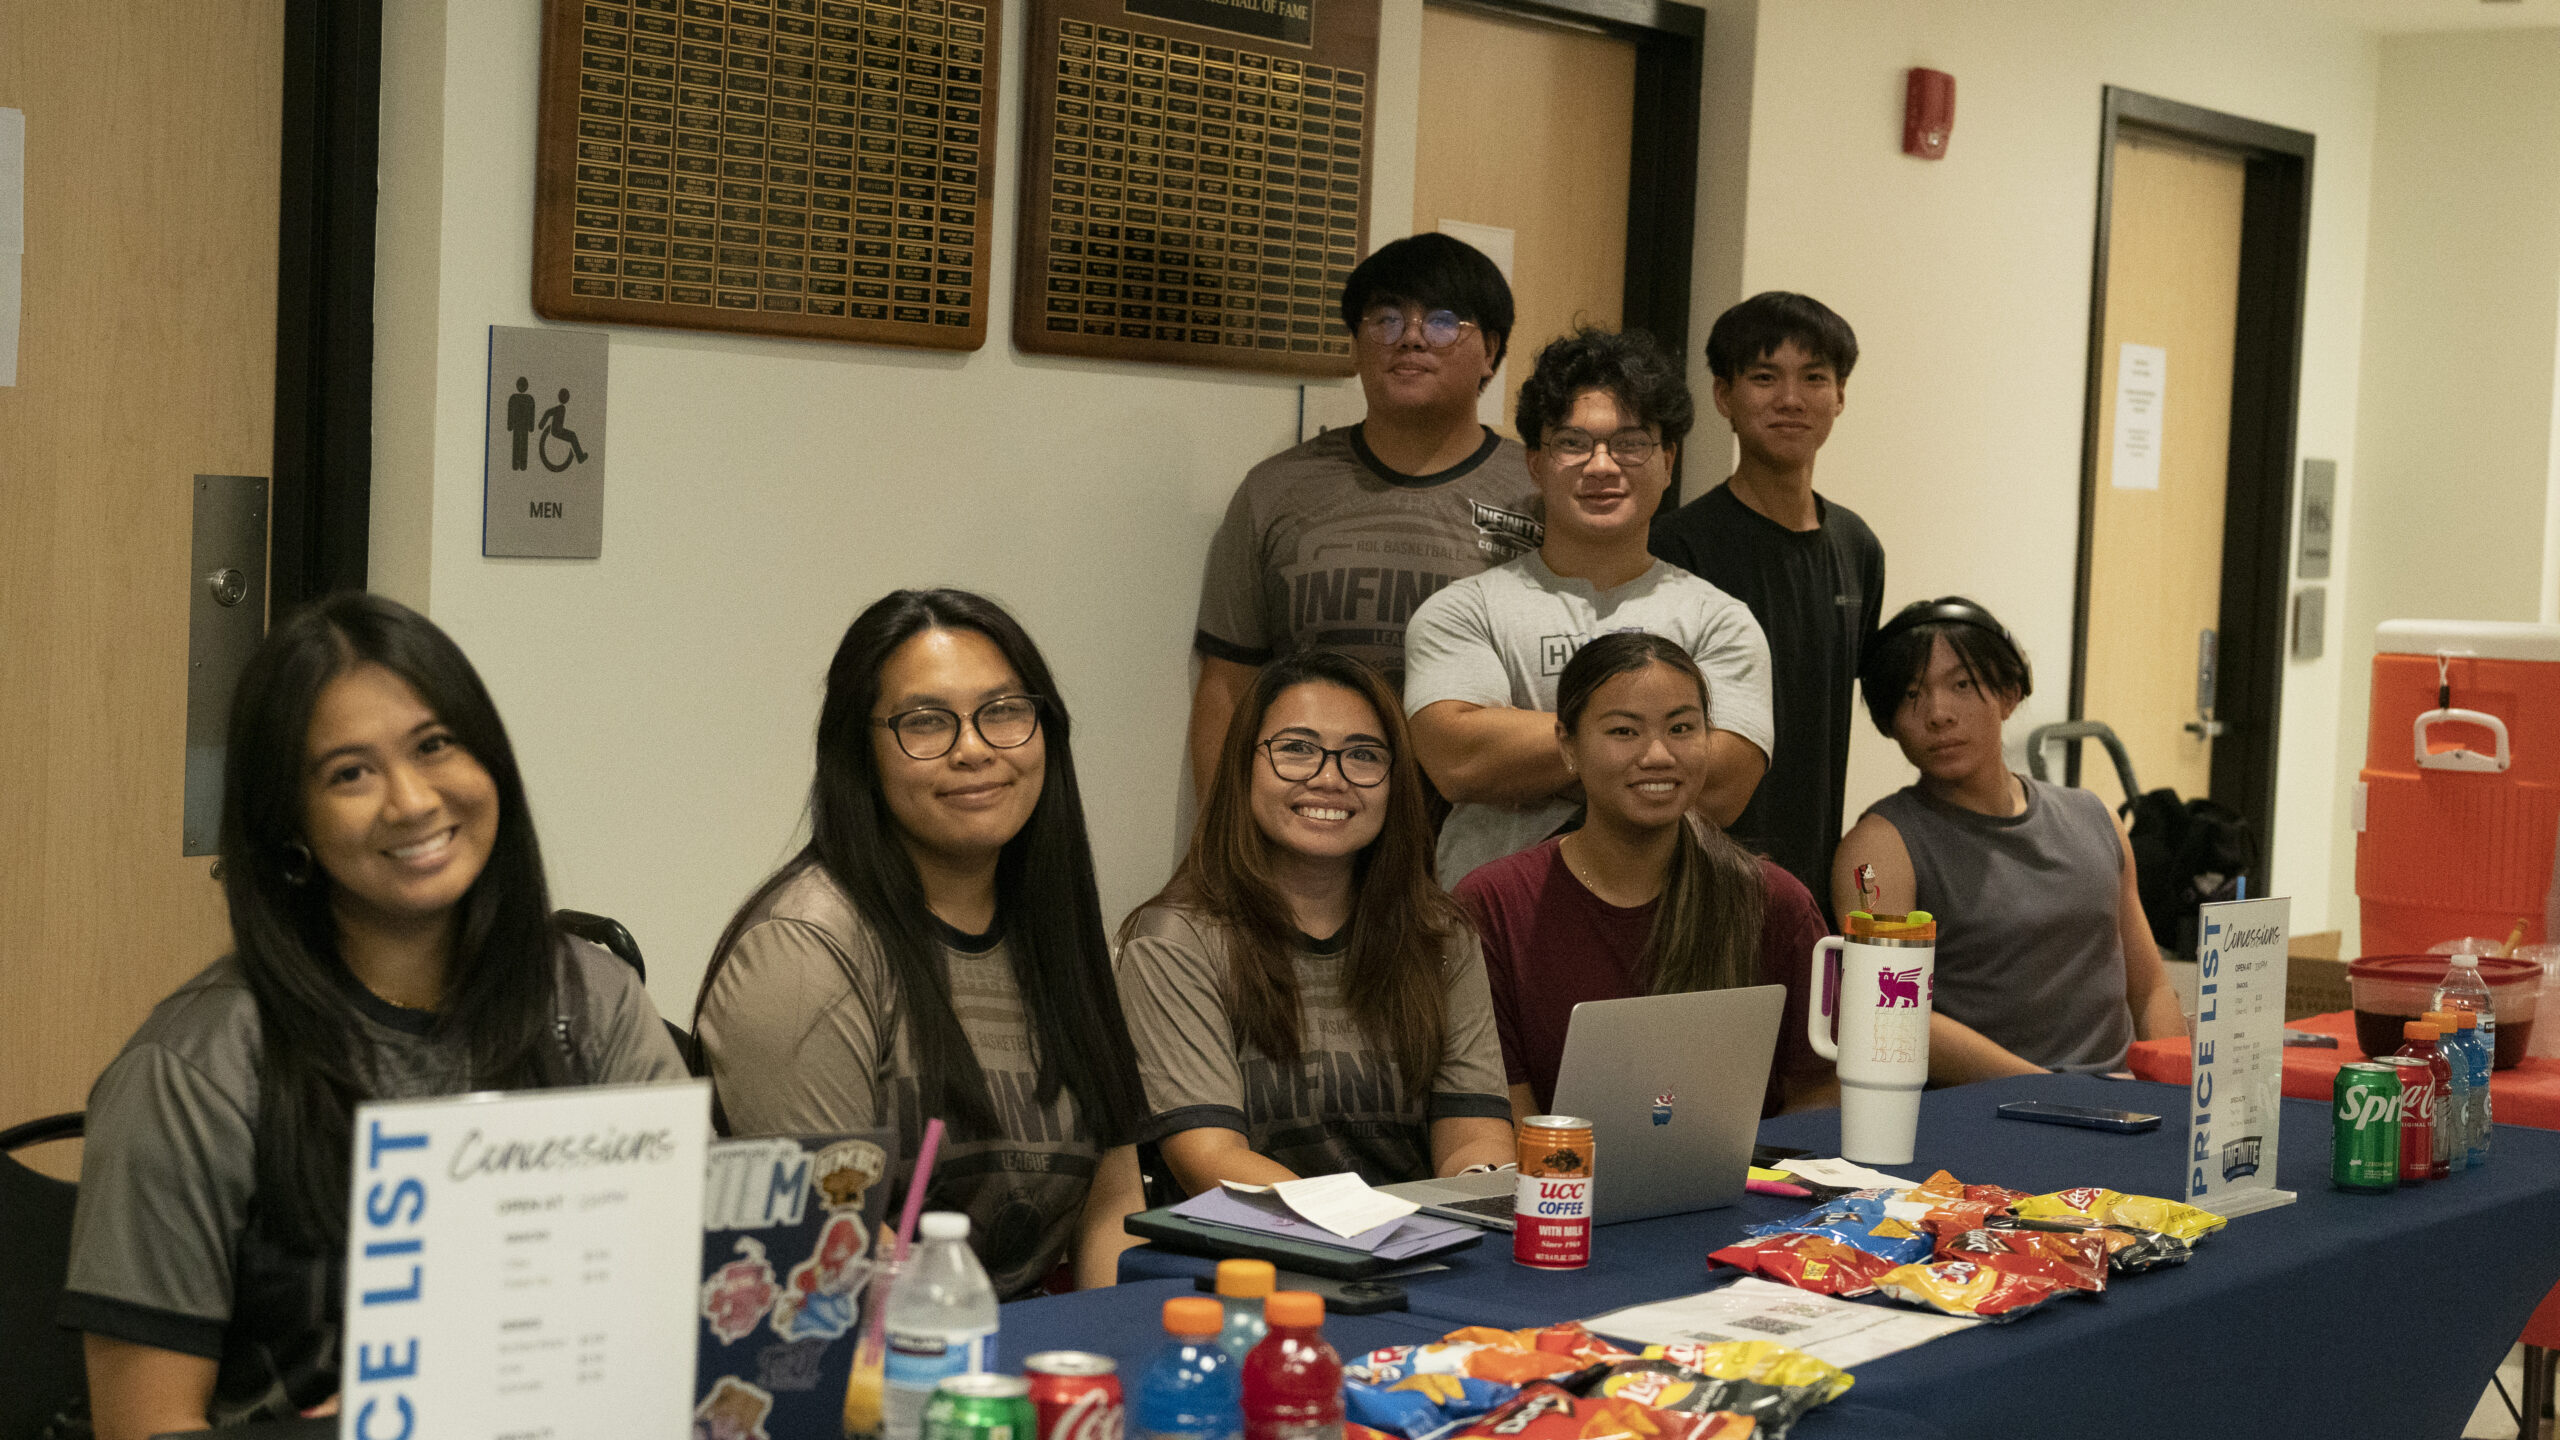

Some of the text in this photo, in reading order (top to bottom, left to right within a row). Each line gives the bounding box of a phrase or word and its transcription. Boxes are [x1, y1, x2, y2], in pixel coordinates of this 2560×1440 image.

[1262, 0, 1277, 14] OF
[1278, 2, 1308, 19] FAME
[530, 501, 562, 518] MEN
[1477, 505, 1544, 541] INFINITE
[1478, 539, 1505, 554] CORE
[2223, 923, 2280, 952] Concessions
[2191, 915, 2221, 1197] PRICE LIST
[448, 1127, 673, 1182] Concessions
[1000, 1152, 1051, 1172] LEAGUE
[363, 1120, 428, 1306] LIST
[1538, 1201, 1584, 1215] COFFEE
[1538, 1225, 1584, 1237] WITH MILK
